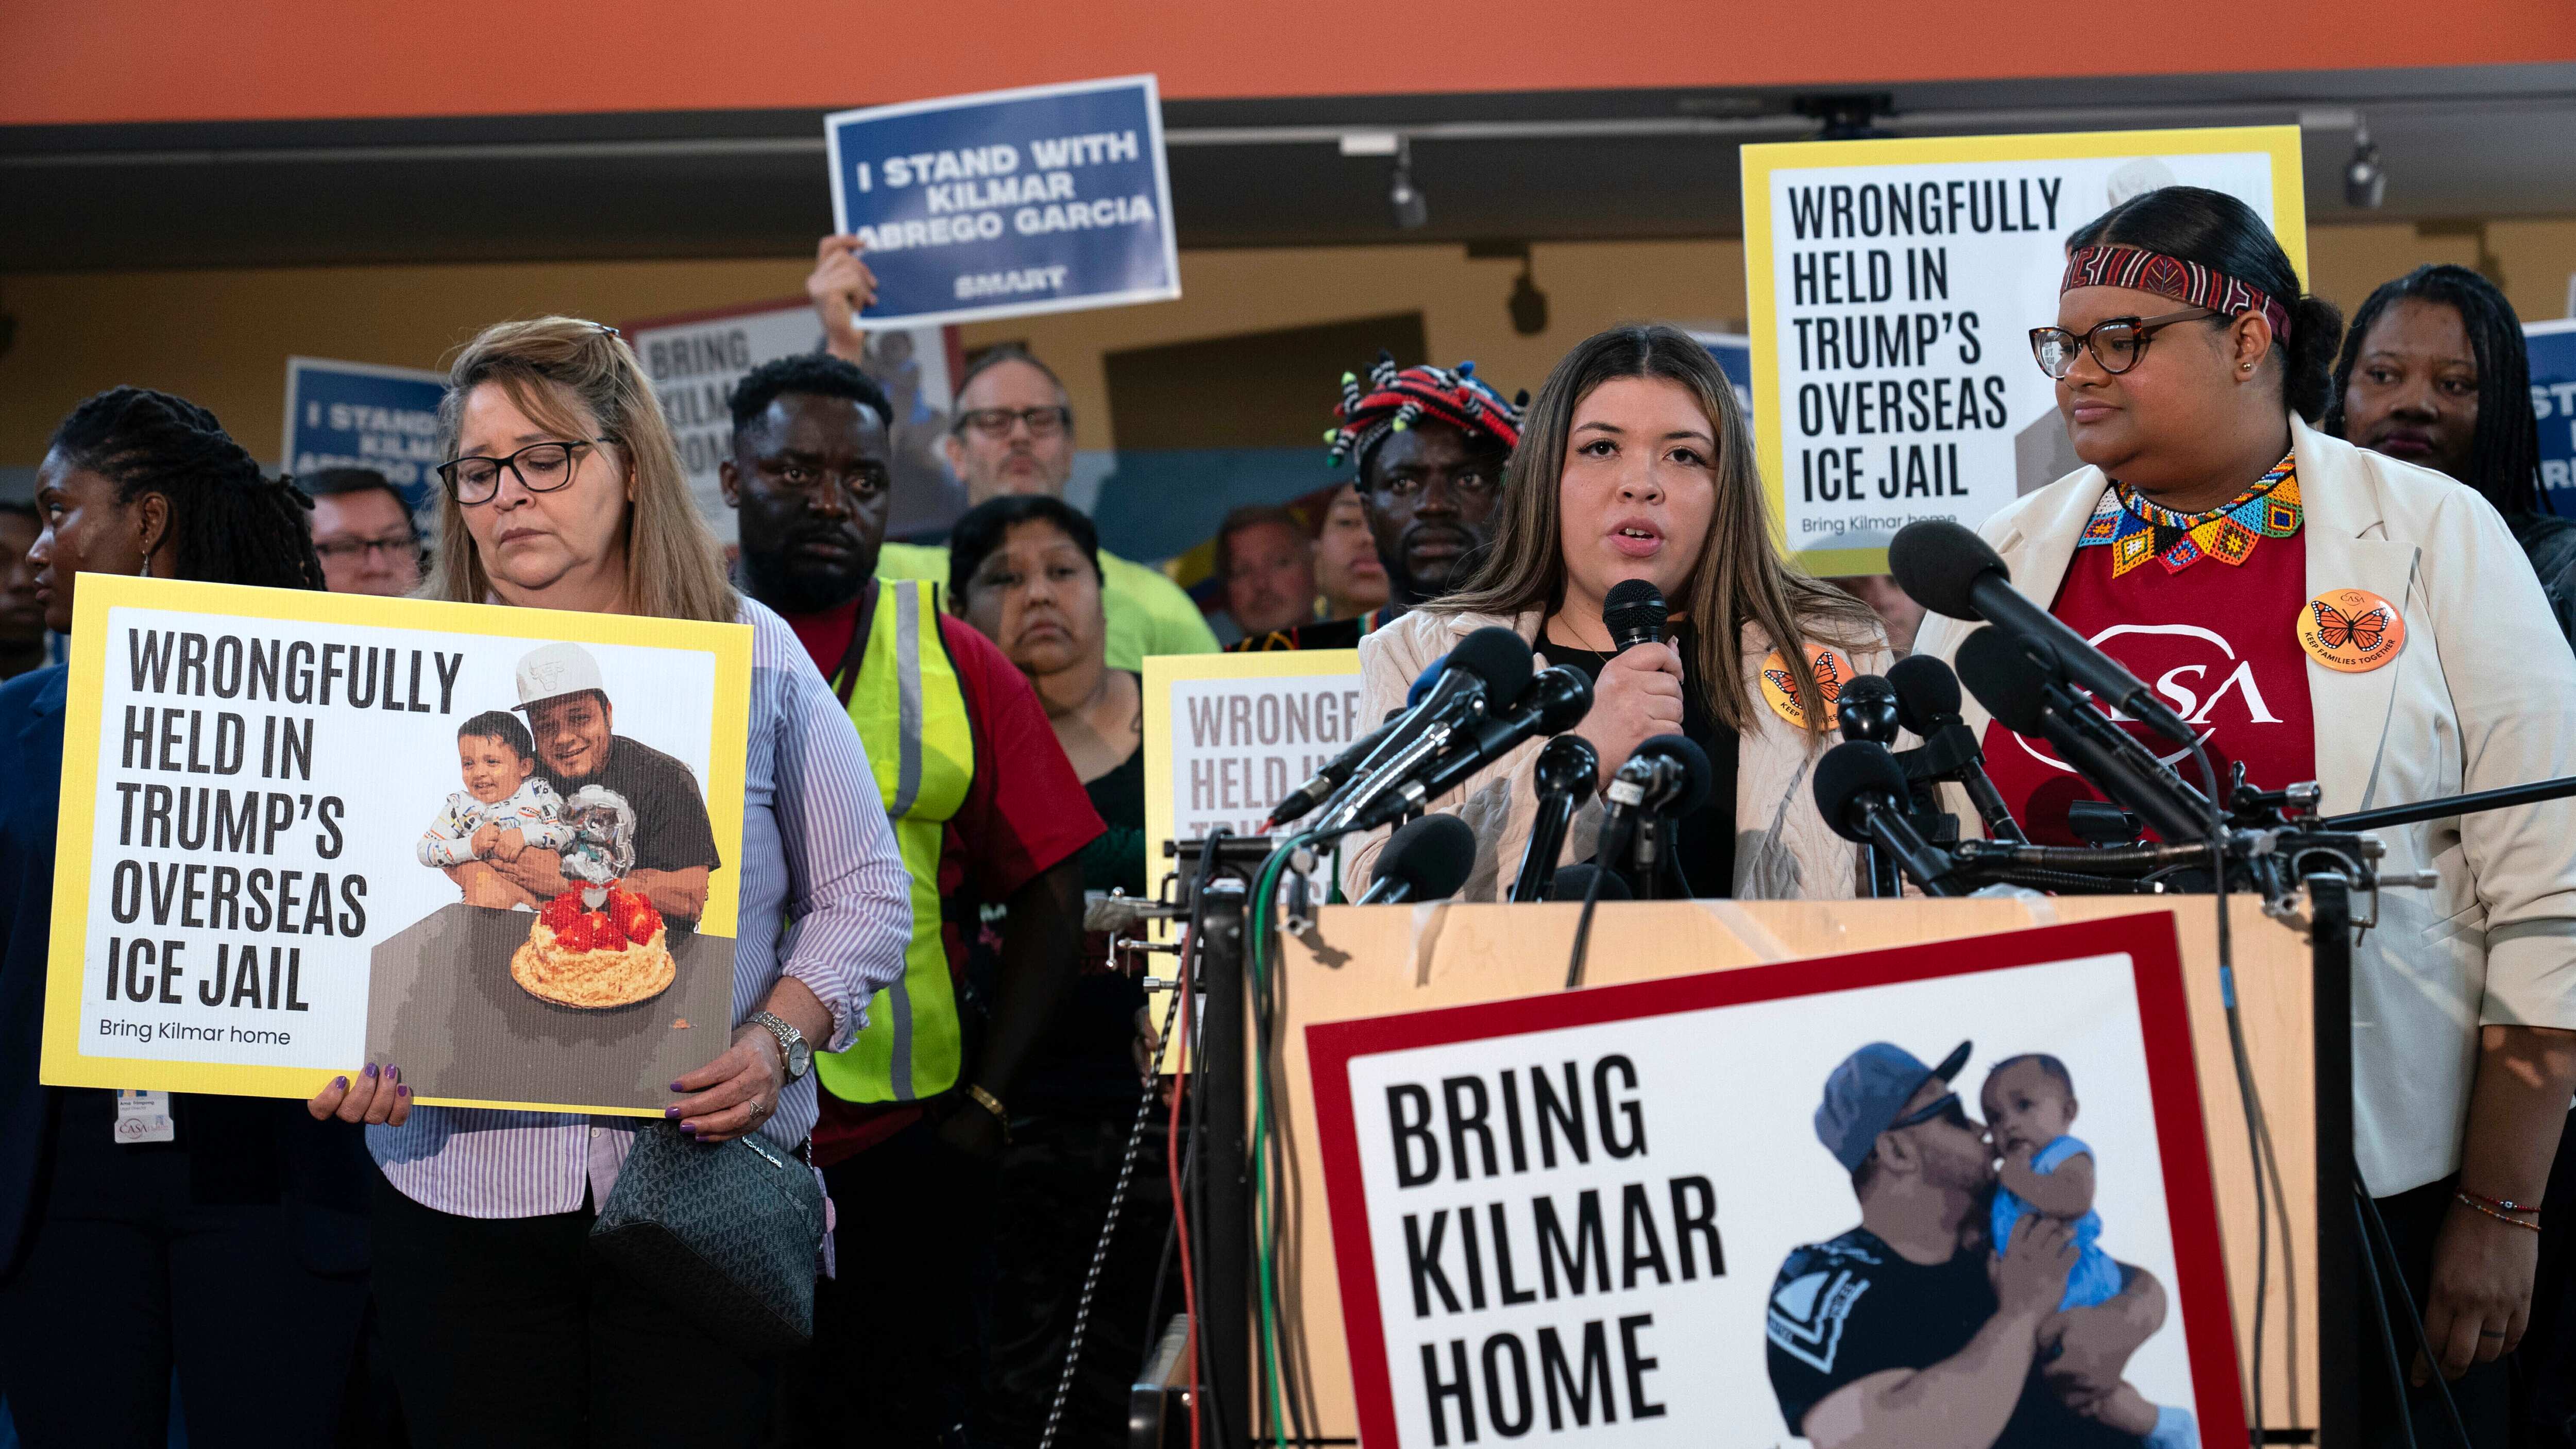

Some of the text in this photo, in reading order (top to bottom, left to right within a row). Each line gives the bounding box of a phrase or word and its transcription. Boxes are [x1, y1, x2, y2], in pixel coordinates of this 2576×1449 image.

[857, 130, 1139, 193] I STAND WITH
[927, 171, 1076, 214] KILMAR
[1788, 178, 2061, 240] WRONGFULLY
[856, 194, 1156, 252] ABREGO GARCIA
[954, 265, 1067, 300] SMART
[1793, 247, 1947, 305] HELD IN
[649, 328, 749, 381] BRING
[1793, 311, 1981, 371] TRUMP'S
[660, 378, 734, 429] KILM
[1799, 376, 2007, 437] OVERSEAS
[1803, 443, 1968, 502] ICE JAIL
[1803, 517, 1844, 535] Bring
[1850, 515, 1903, 531] Kilmar
[2341, 594, 2365, 603] CASA
[129, 628, 463, 714] WRONGFULLY
[2305, 632, 2395, 664] KEEP FAMILIES TOGETHER
[1188, 689, 1360, 746] WRONGF
[1781, 702, 1800, 717] KEEP
[122, 705, 314, 781] HELD IN
[1191, 757, 1287, 810] HELD
[116, 782, 344, 860] TRUMP'S
[111, 859, 367, 938] OVERSEAS
[106, 937, 309, 1012] ICE JAIL
[100, 1019, 291, 1045] Bring Kilmar home
[1386, 1054, 1647, 1188] BRING
[742, 1136, 782, 1168] MICHAEL KORS
[1403, 1175, 1725, 1318] KILMAR
[1420, 1314, 1666, 1447] HOME
